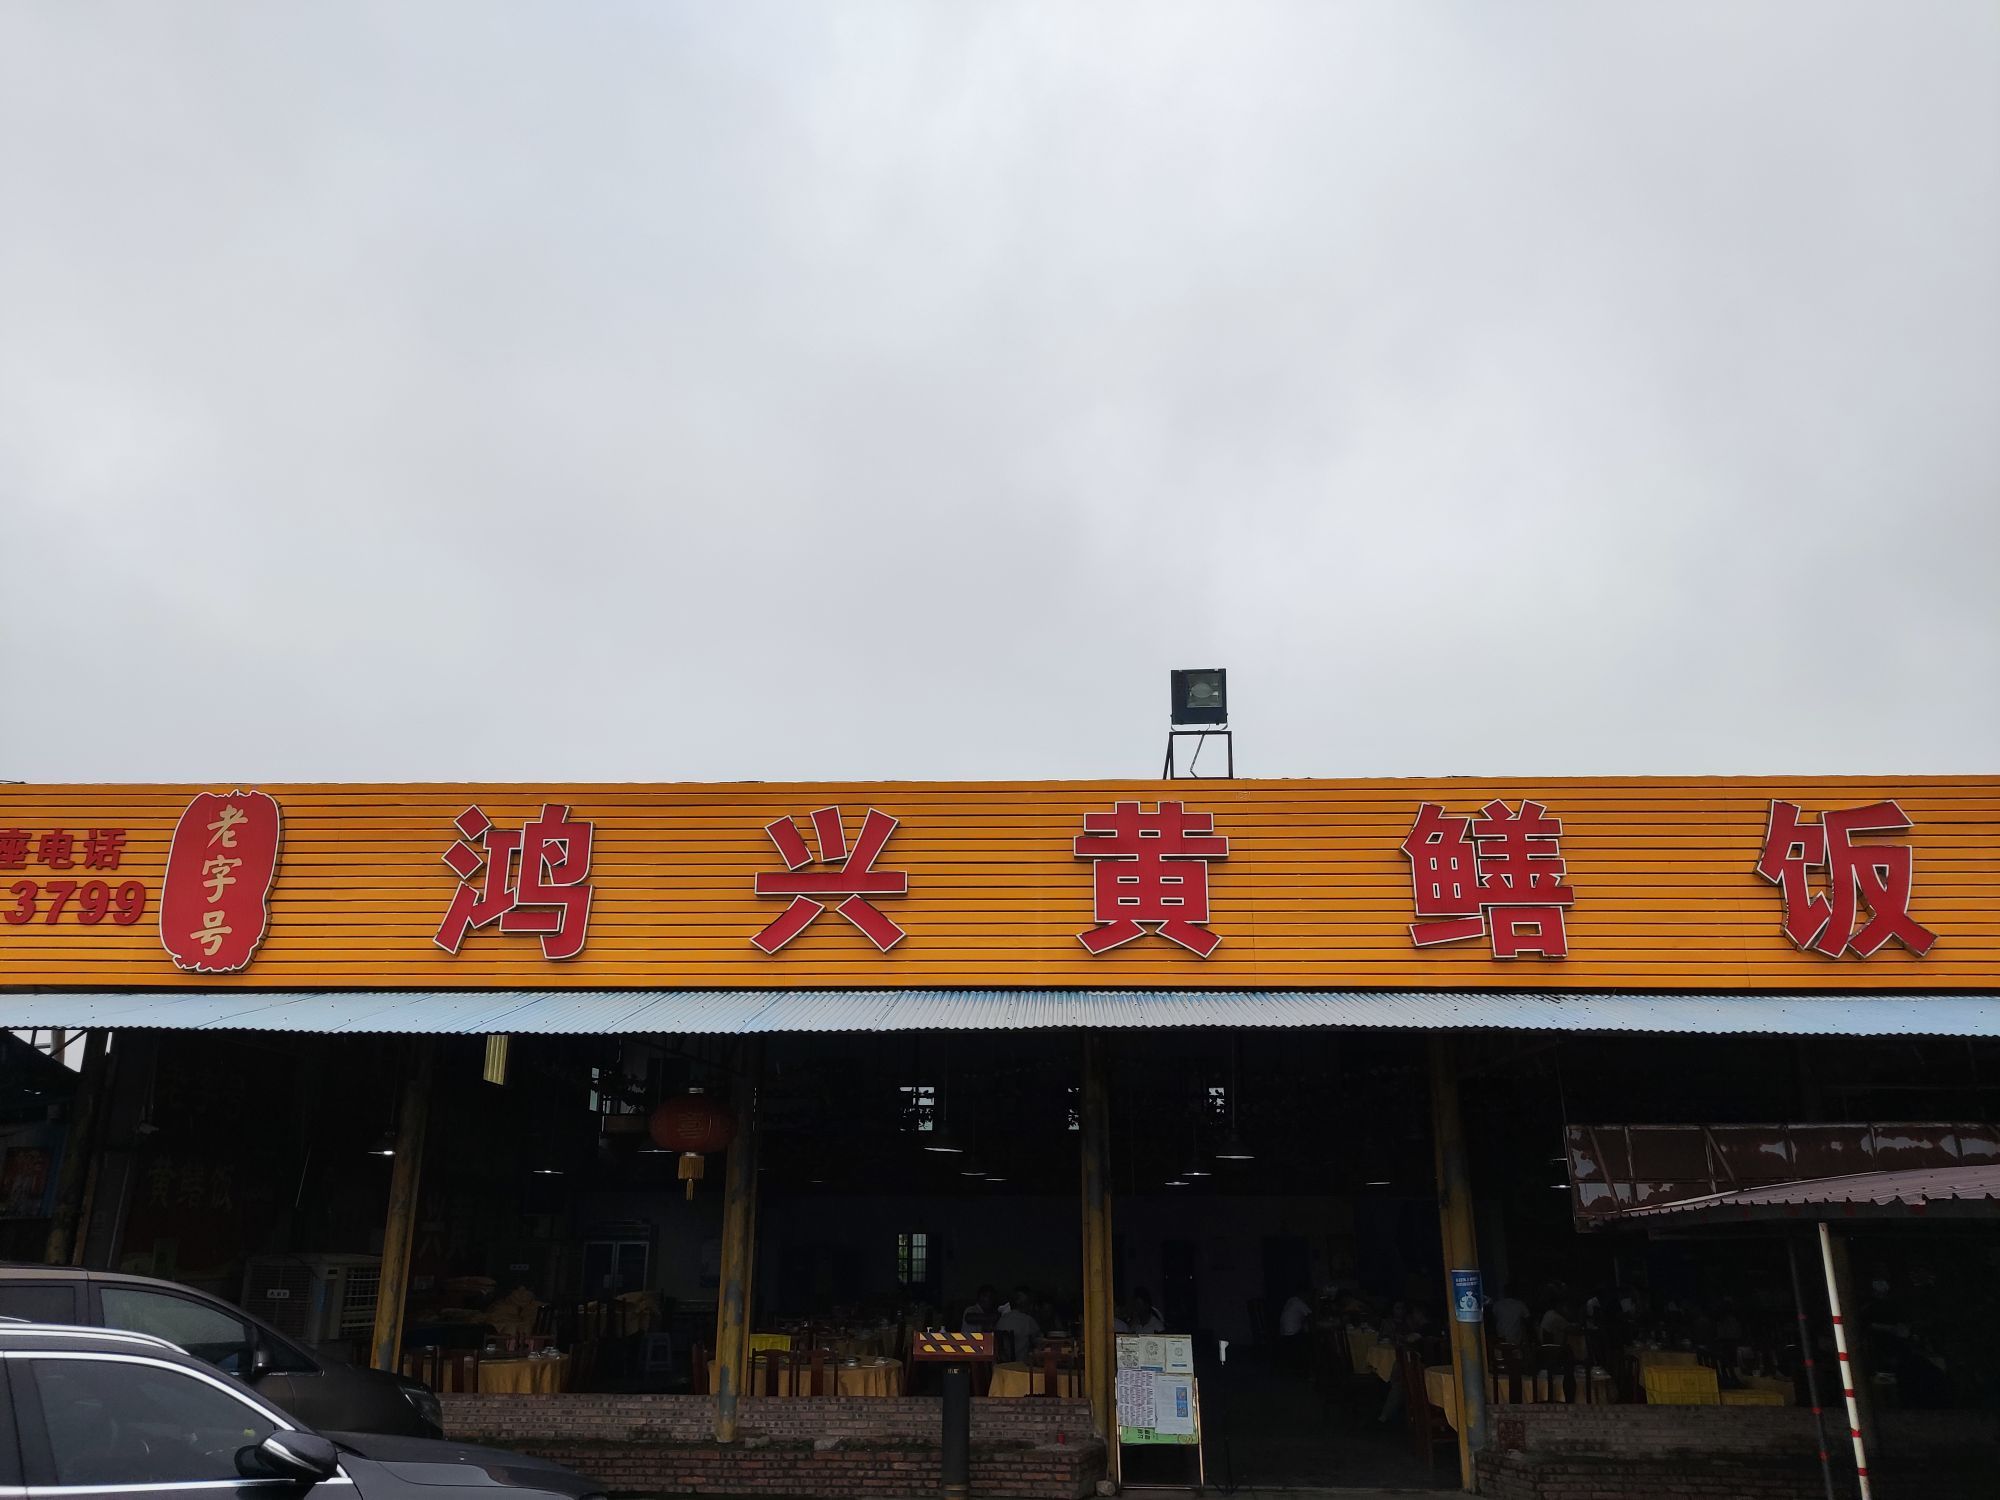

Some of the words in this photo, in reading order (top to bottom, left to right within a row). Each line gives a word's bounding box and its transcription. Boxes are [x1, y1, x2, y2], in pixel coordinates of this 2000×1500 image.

[0, 828, 126, 870] 座电话
[190, 805, 249, 956] 老字号
[433, 799, 1938, 961] 鸿兴黄鳝饭
[4, 880, 146, 925] 3799
